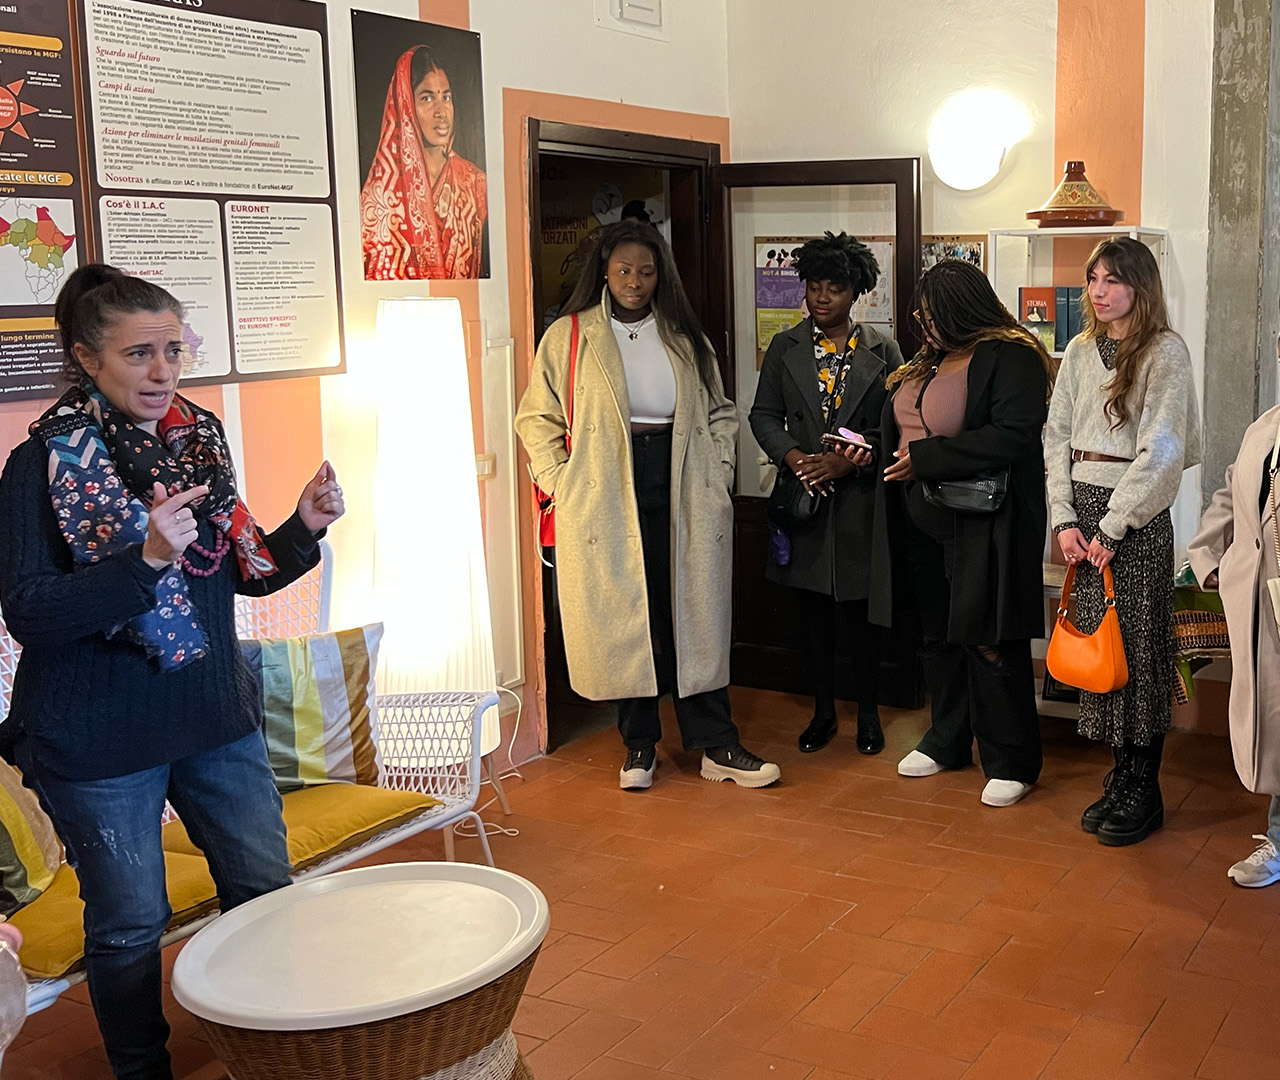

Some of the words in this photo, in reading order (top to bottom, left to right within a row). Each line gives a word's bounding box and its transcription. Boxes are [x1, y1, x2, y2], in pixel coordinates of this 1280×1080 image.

[95, 45, 125, 59] Sguardo
[127, 50, 137, 58] sul
[136, 51, 160, 64] futuro
[98, 80, 122, 92] Campi
[123, 82, 131, 90] di
[132, 83, 154, 93] azioni
[101, 126, 126, 135] Azione
[128, 131, 139, 139] per
[141, 129, 174, 139] eliminare
[175, 132, 181, 140] le
[183, 133, 222, 143] mutilazioni
[223, 137, 248, 147] genitali
[247, 138, 280, 150] femminili
[25, 173, 35, 182] le
[38, 174, 62, 182] MGF
[105, 172, 143, 183] Nosotras
[106, 199, 131, 208] Cos'è
[142, 201, 165, 209] I.A.C
[230, 204, 270, 213] EURONET
[543, 230, 578, 244] ORZATI
